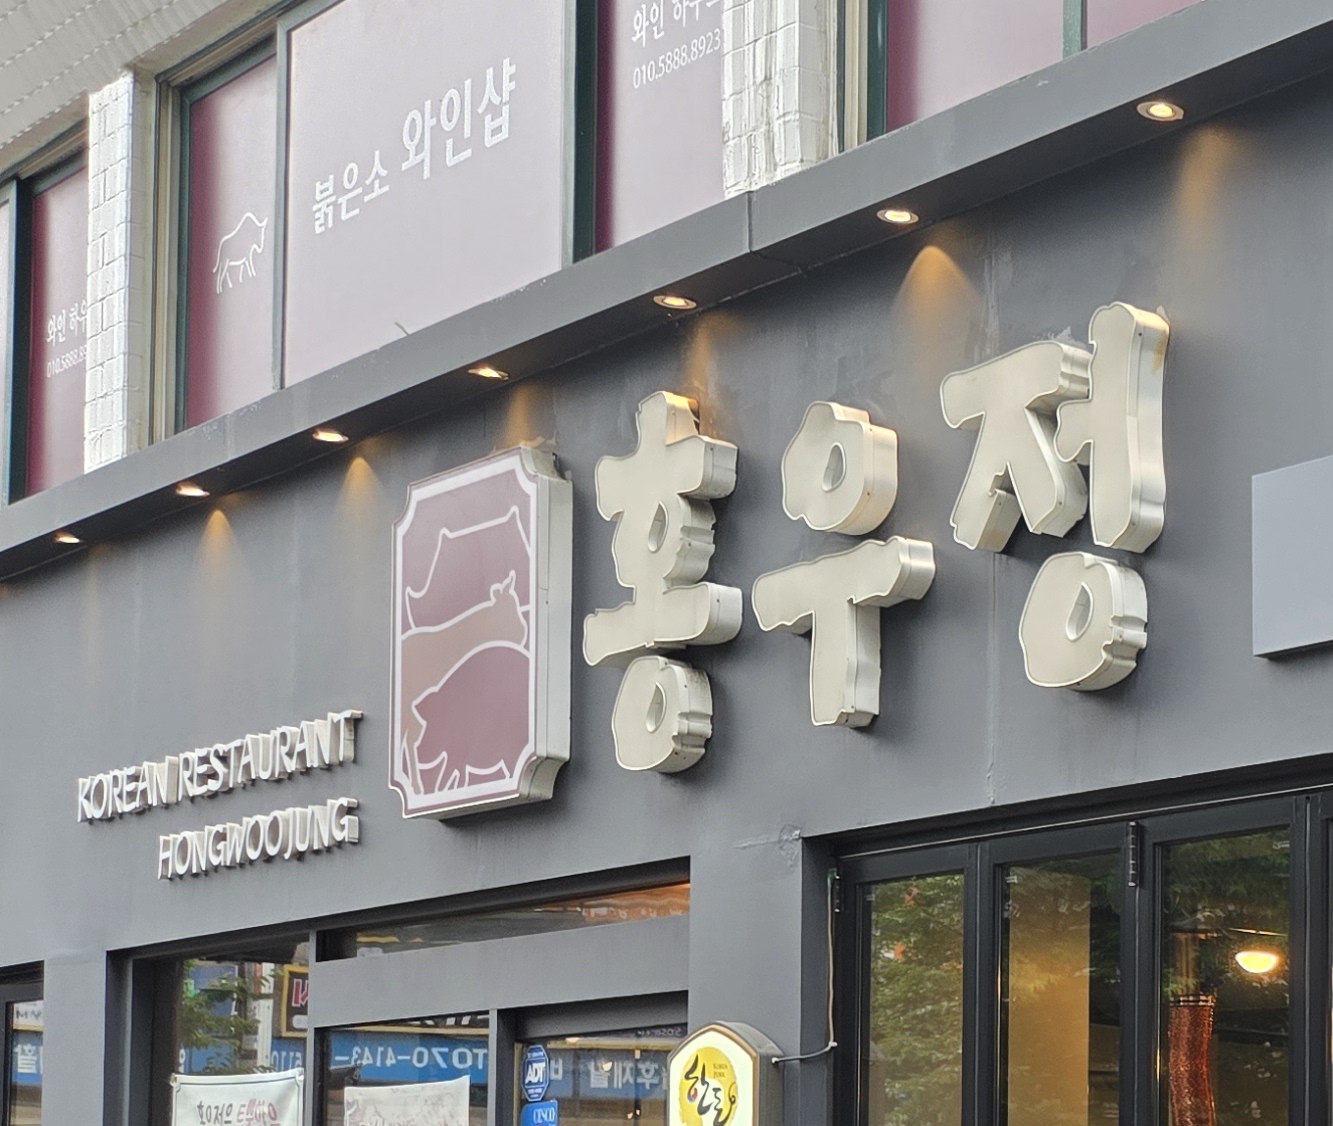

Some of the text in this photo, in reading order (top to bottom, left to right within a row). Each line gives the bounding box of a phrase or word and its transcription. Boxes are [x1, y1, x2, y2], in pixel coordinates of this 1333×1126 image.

[632, 27, 721, 89] 010.5888.8923
[312, 57, 516, 234] 붉은소 와인샵
[68, 298, 87, 337] 하우
[583, 301, 1171, 773] 홍우정
[77, 708, 364, 823] KOREAN RESTAURANT
[157, 796, 360, 880] HONGWOOJUNG
[525, 1062, 546, 1084] ADT
